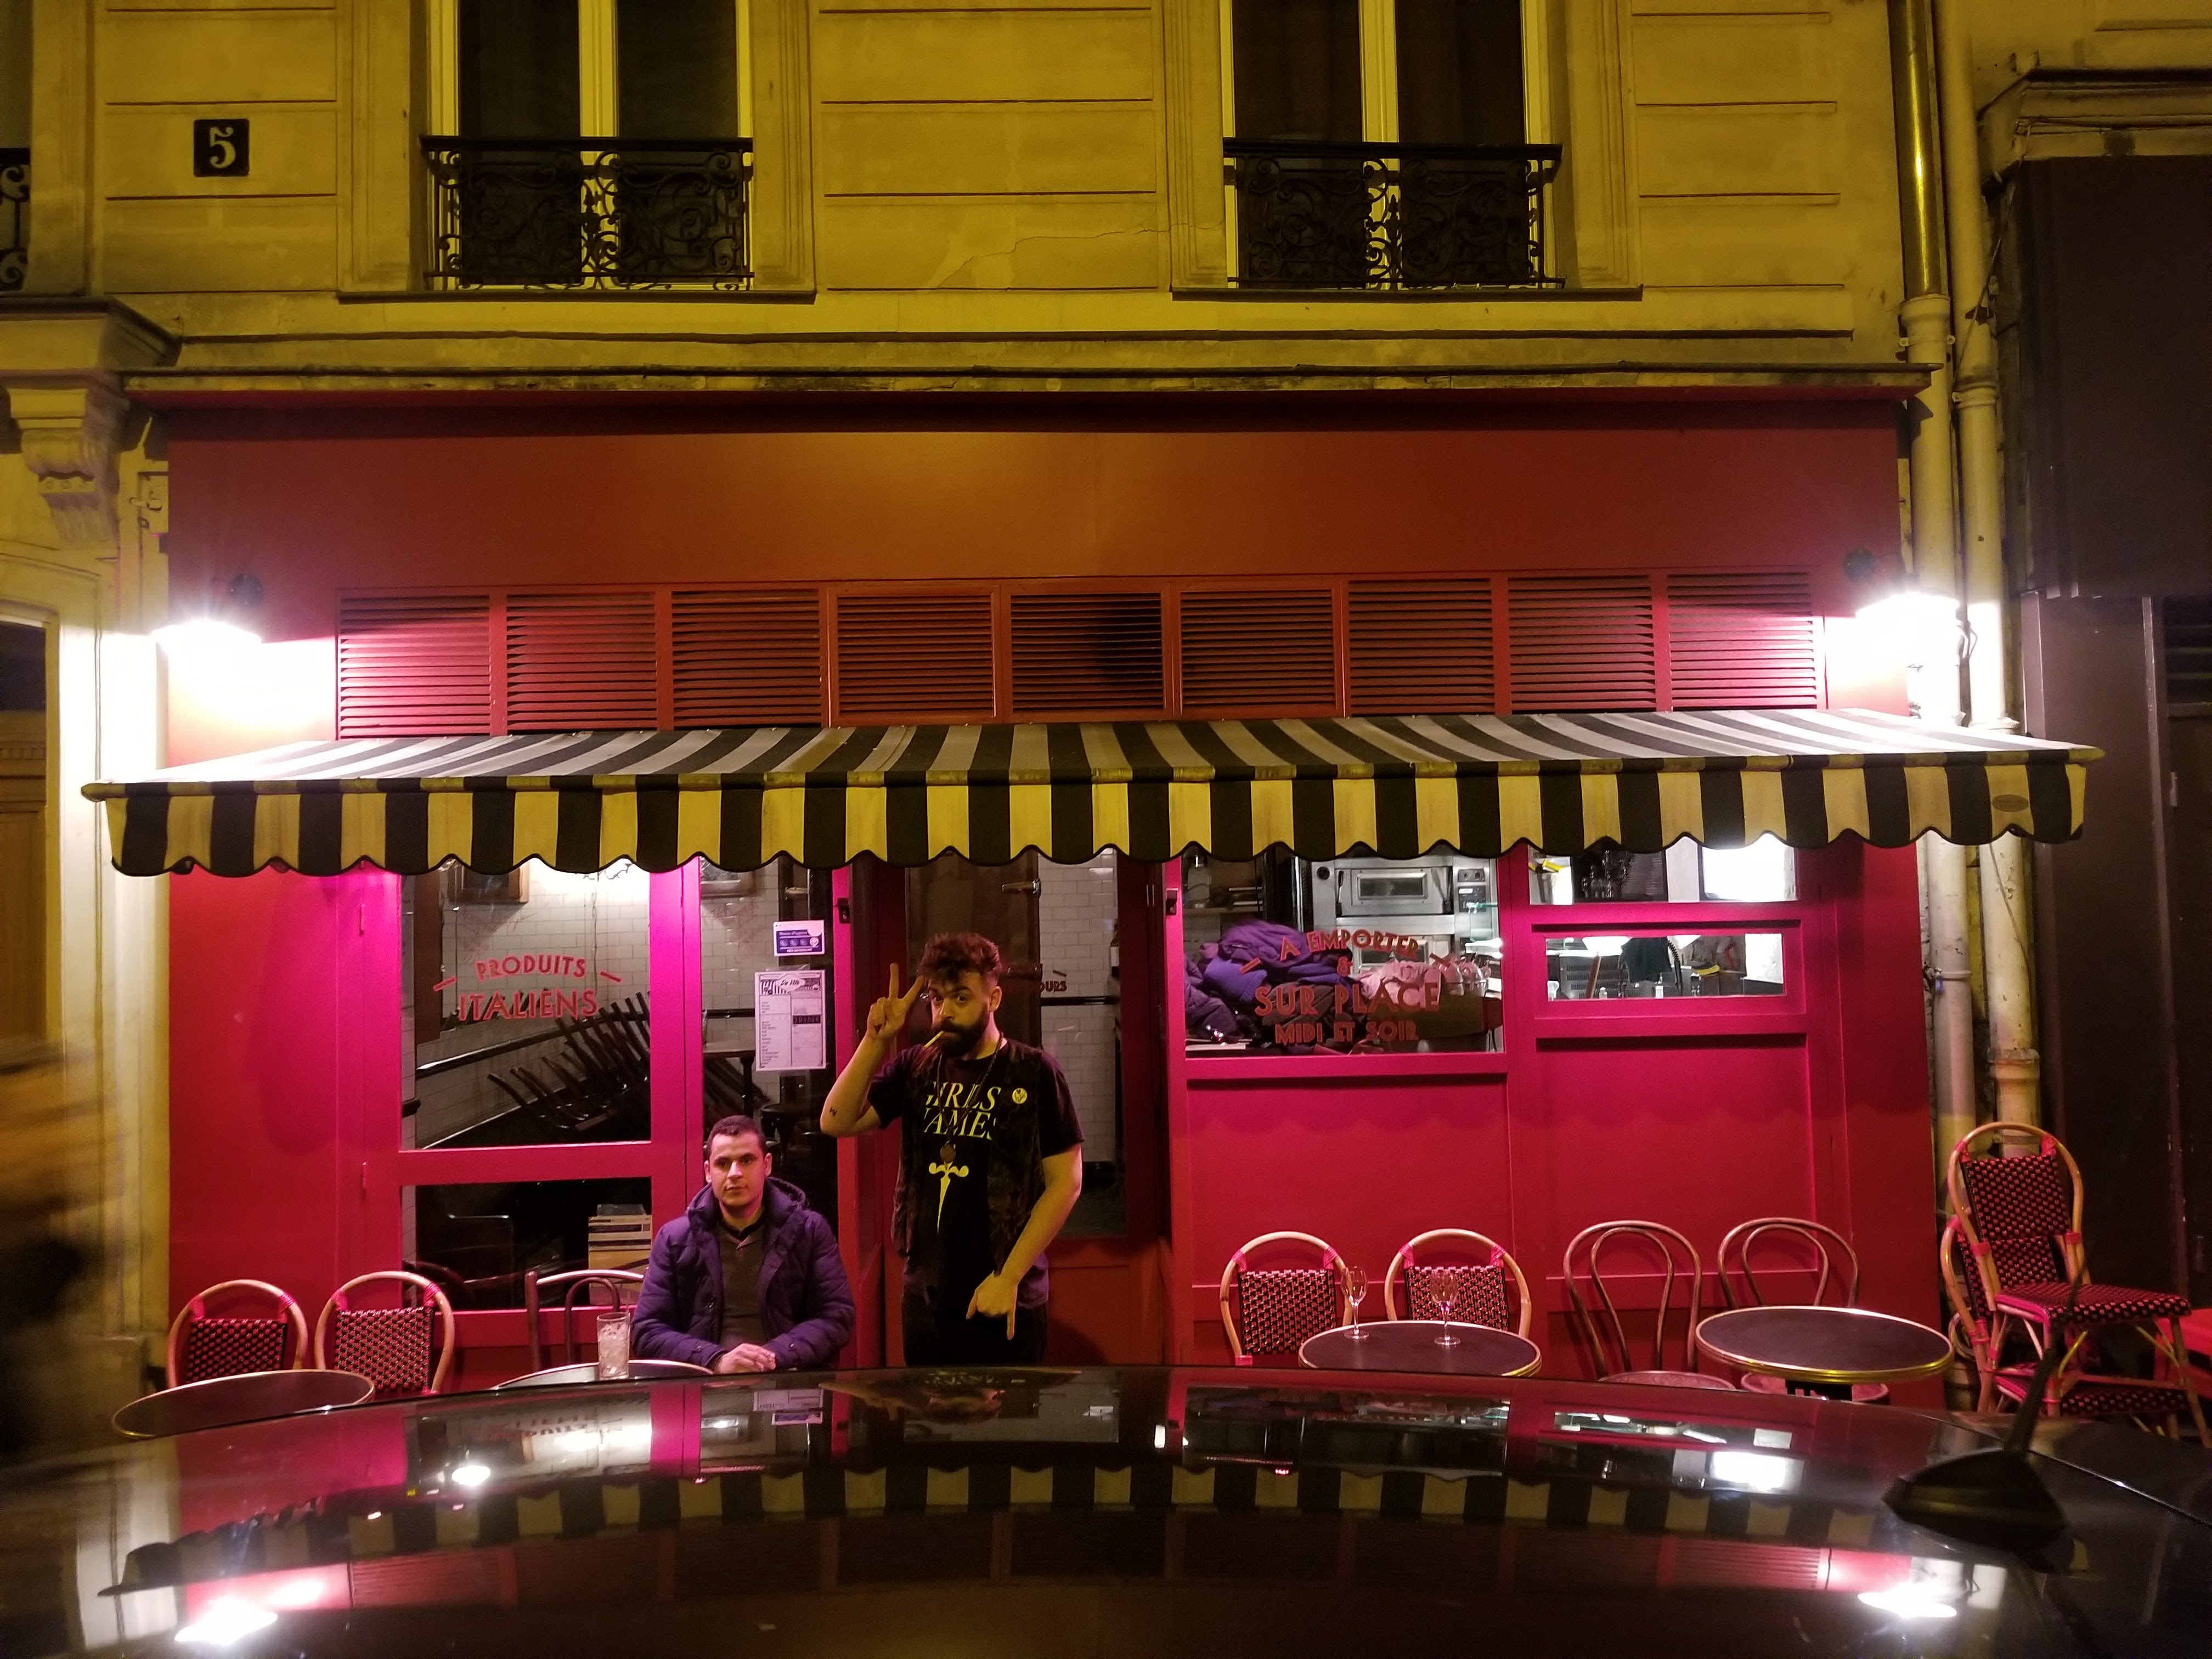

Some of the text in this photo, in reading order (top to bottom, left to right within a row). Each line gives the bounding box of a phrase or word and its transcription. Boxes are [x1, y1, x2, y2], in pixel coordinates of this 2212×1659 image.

[209, 126, 236, 169] 5
[1279, 928, 1419, 962] A EMPORTER
[475, 952, 586, 982] PRODUITS
[1336, 956, 1353, 977] &
[458, 988, 599, 1022] ITALIENS
[1254, 982, 1440, 1017] SUR PLACE
[1274, 1020, 1420, 1046] MIDI ET SOIR
[923, 1107, 997, 1141] AME
